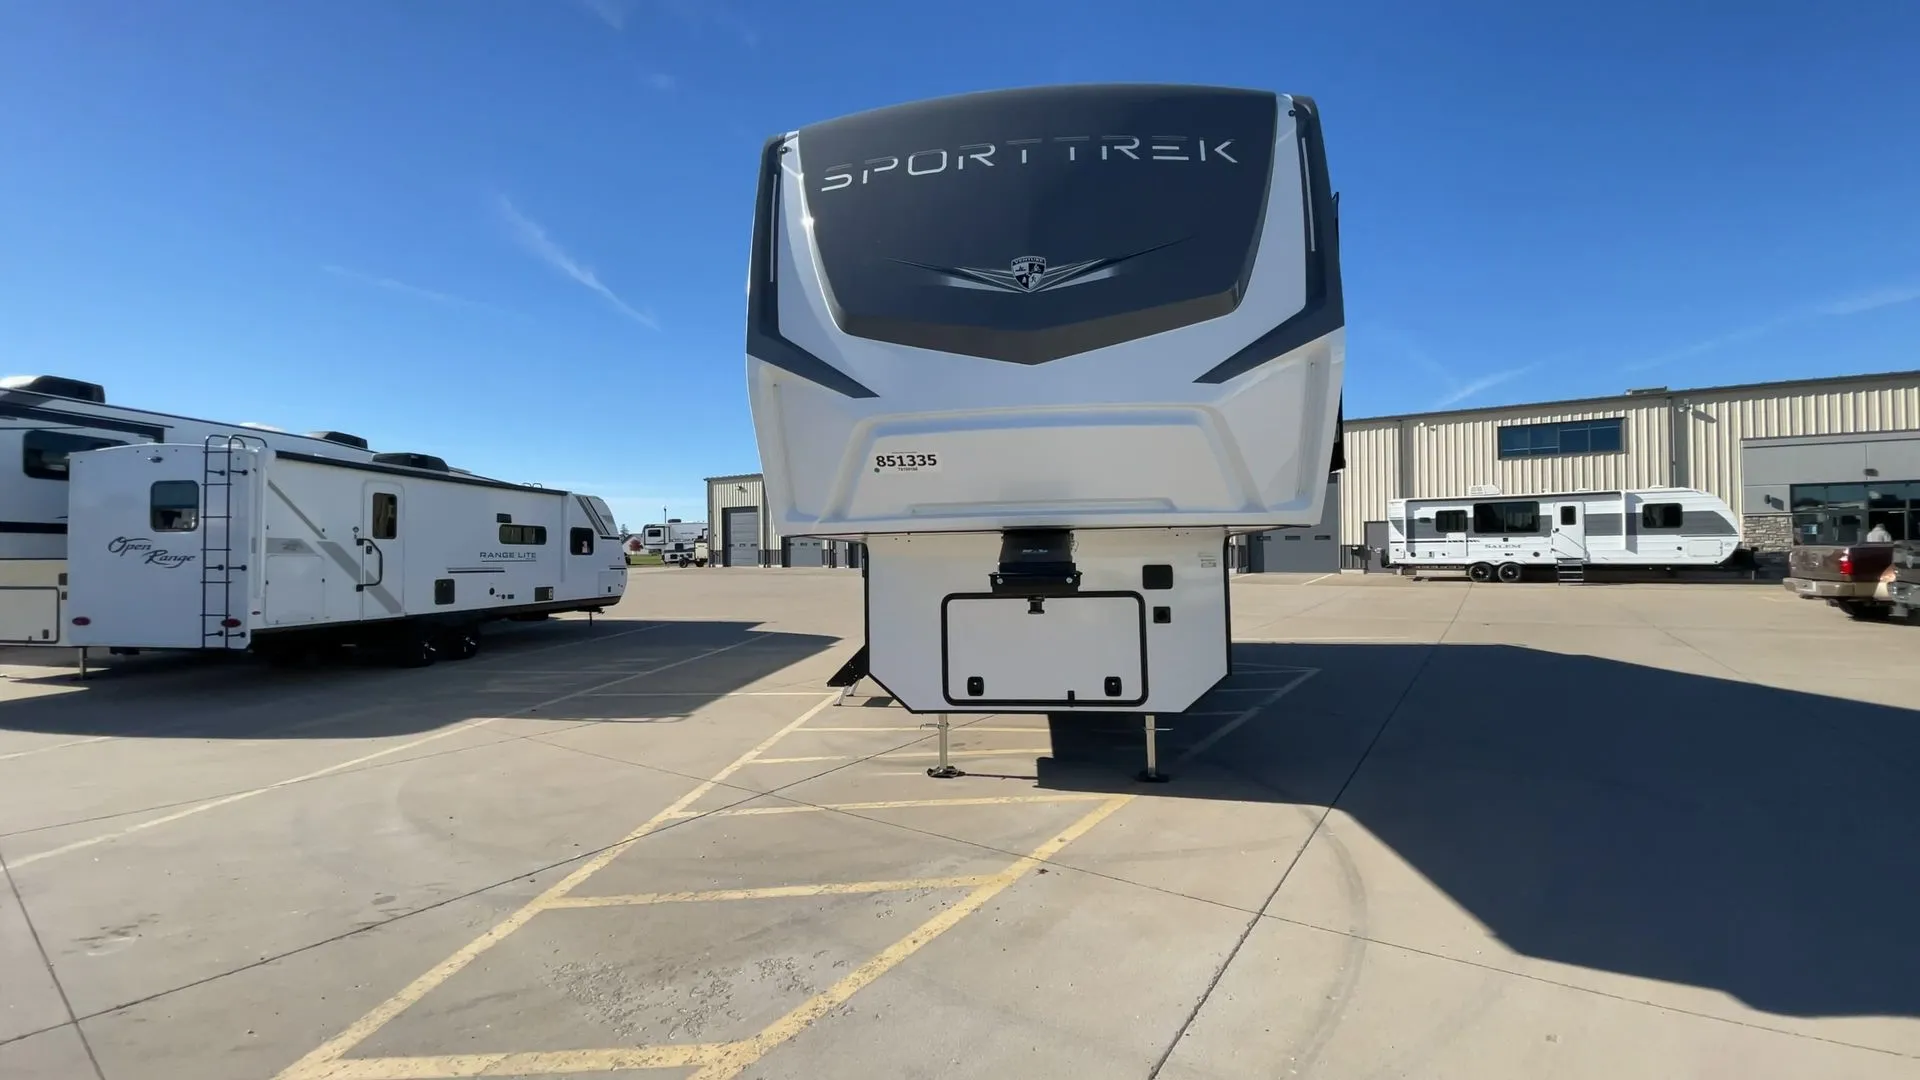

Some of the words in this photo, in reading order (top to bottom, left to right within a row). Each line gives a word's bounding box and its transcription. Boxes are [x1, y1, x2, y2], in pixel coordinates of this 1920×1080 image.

[876, 454, 937, 467] 851335
[108, 536, 153, 557] Open
[142, 549, 196, 569] Range
